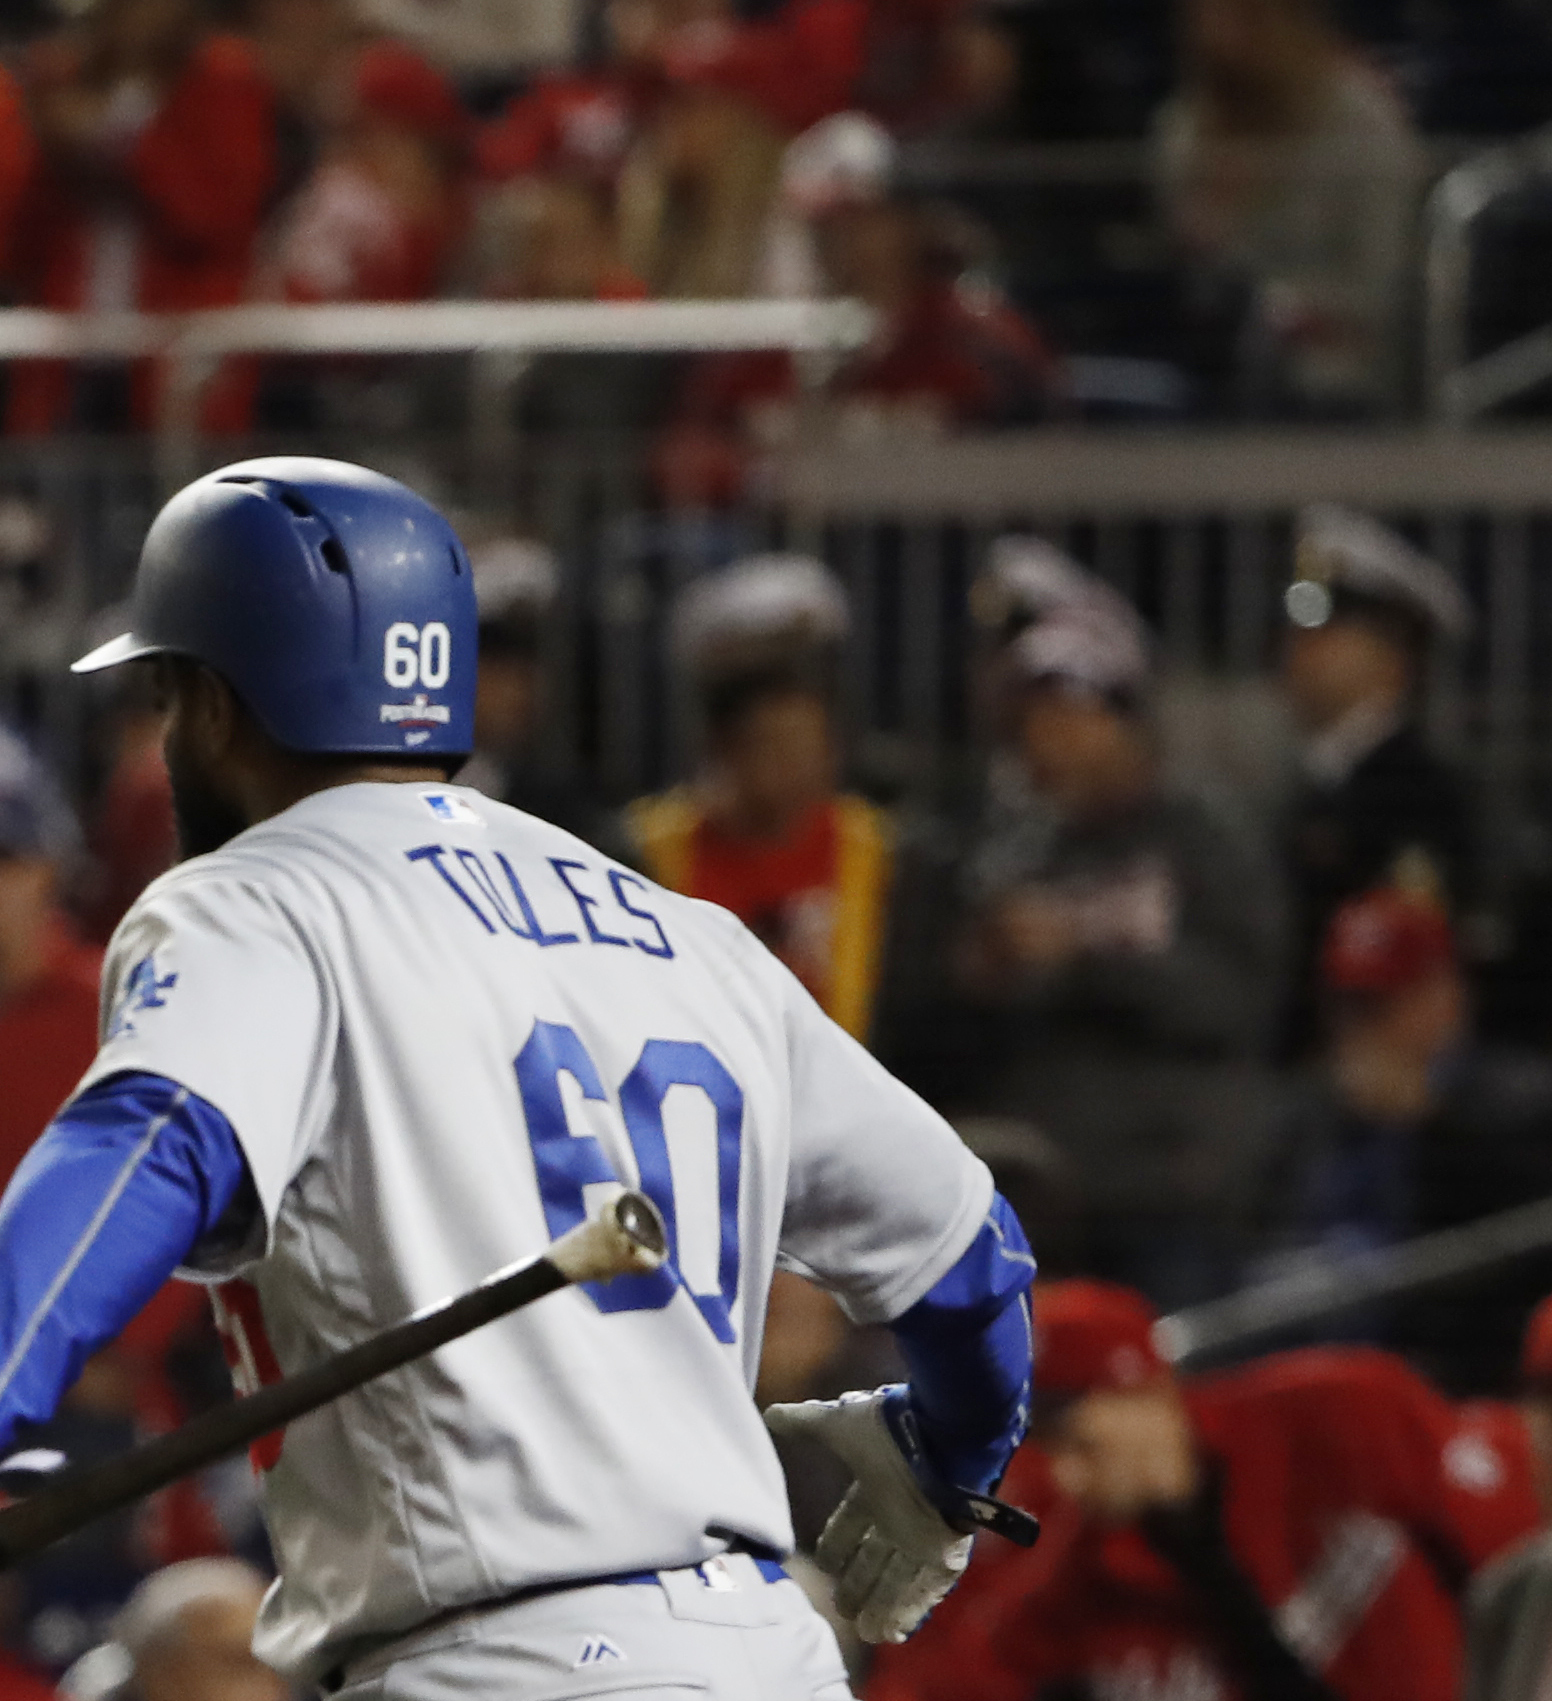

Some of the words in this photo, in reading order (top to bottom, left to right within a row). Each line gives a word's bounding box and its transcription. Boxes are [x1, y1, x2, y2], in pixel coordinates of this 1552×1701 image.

[383, 620, 452, 690] 60
[407, 843, 676, 961] TOLES
[512, 1016, 745, 1344] 60
